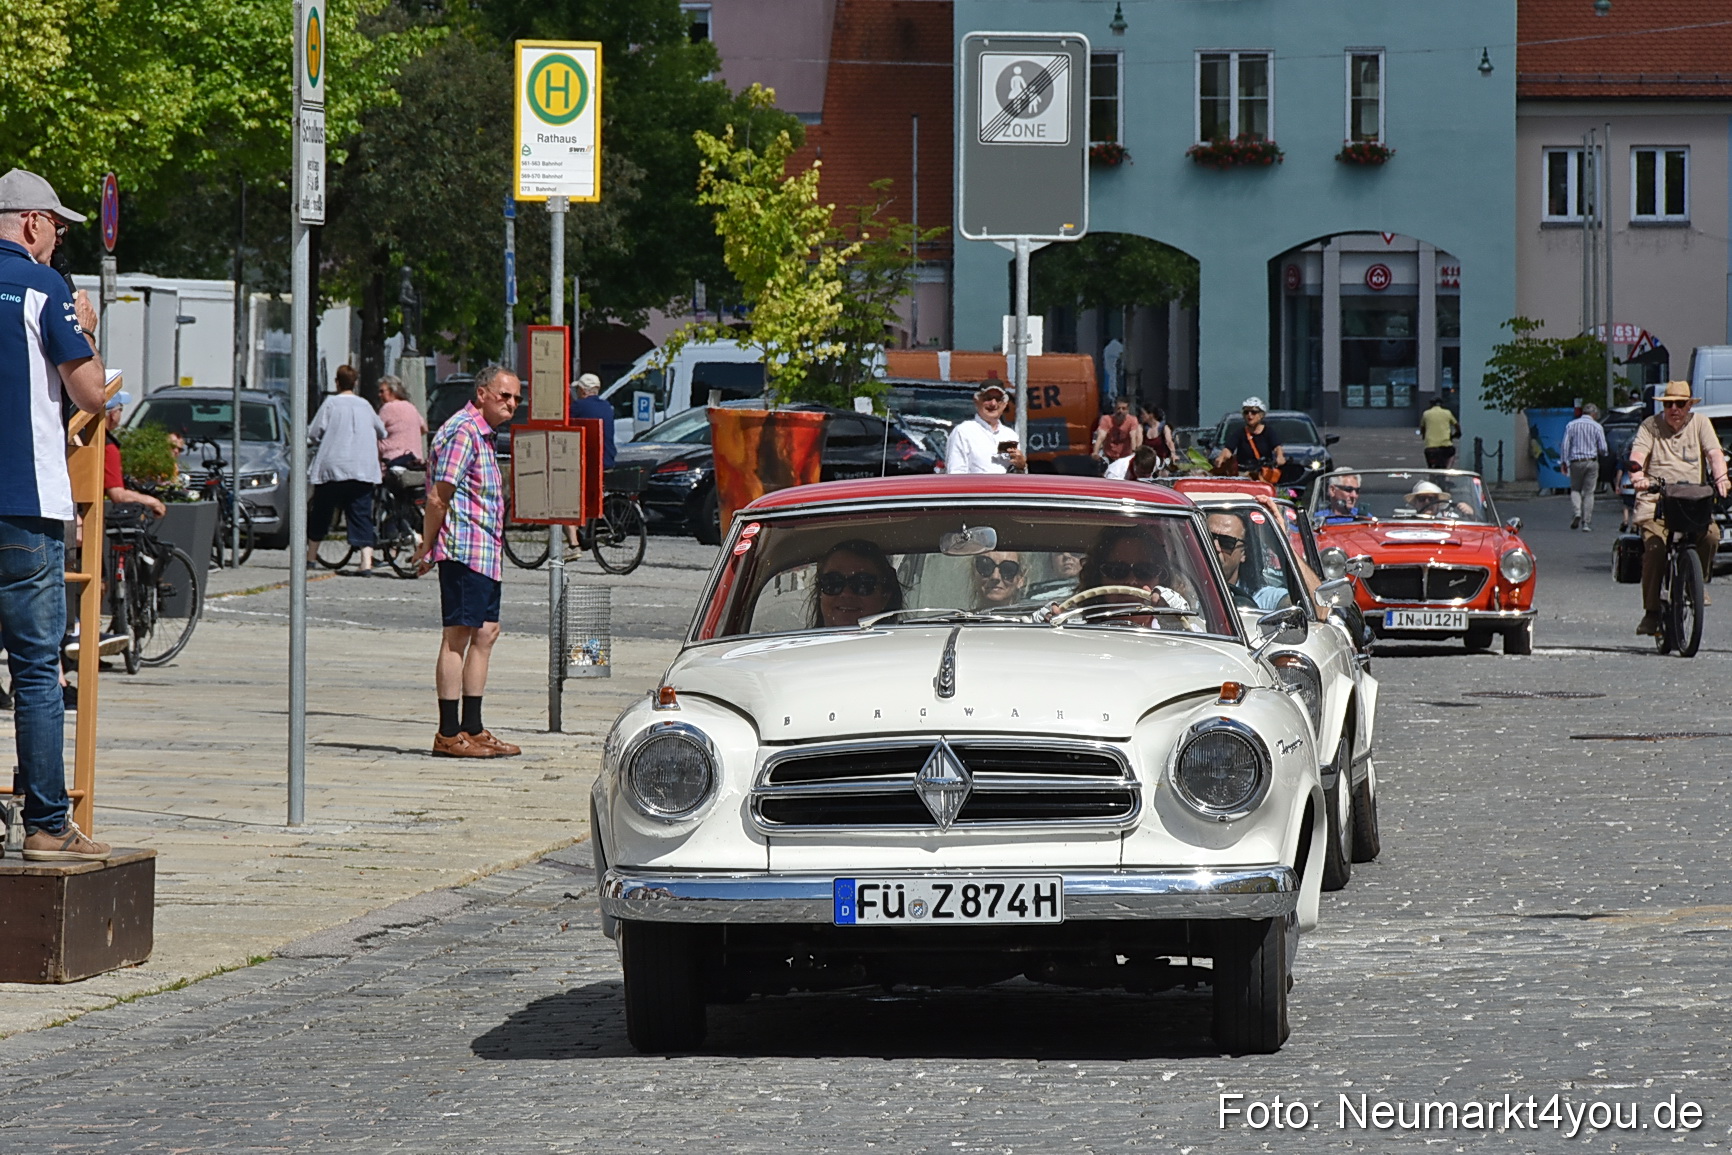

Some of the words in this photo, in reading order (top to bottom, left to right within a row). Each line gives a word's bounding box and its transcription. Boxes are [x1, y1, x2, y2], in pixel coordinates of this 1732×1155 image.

[545, 70, 570, 109] H
[1002, 123, 1047, 138] ZONE
[537, 133, 577, 144] Rathaus
[0, 293, 22, 304] CING
[1397, 613, 1415, 626] IN
[1423, 613, 1462, 627] U12H
[857, 883, 905, 919] FÜ
[931, 882, 1058, 919] Z874H
